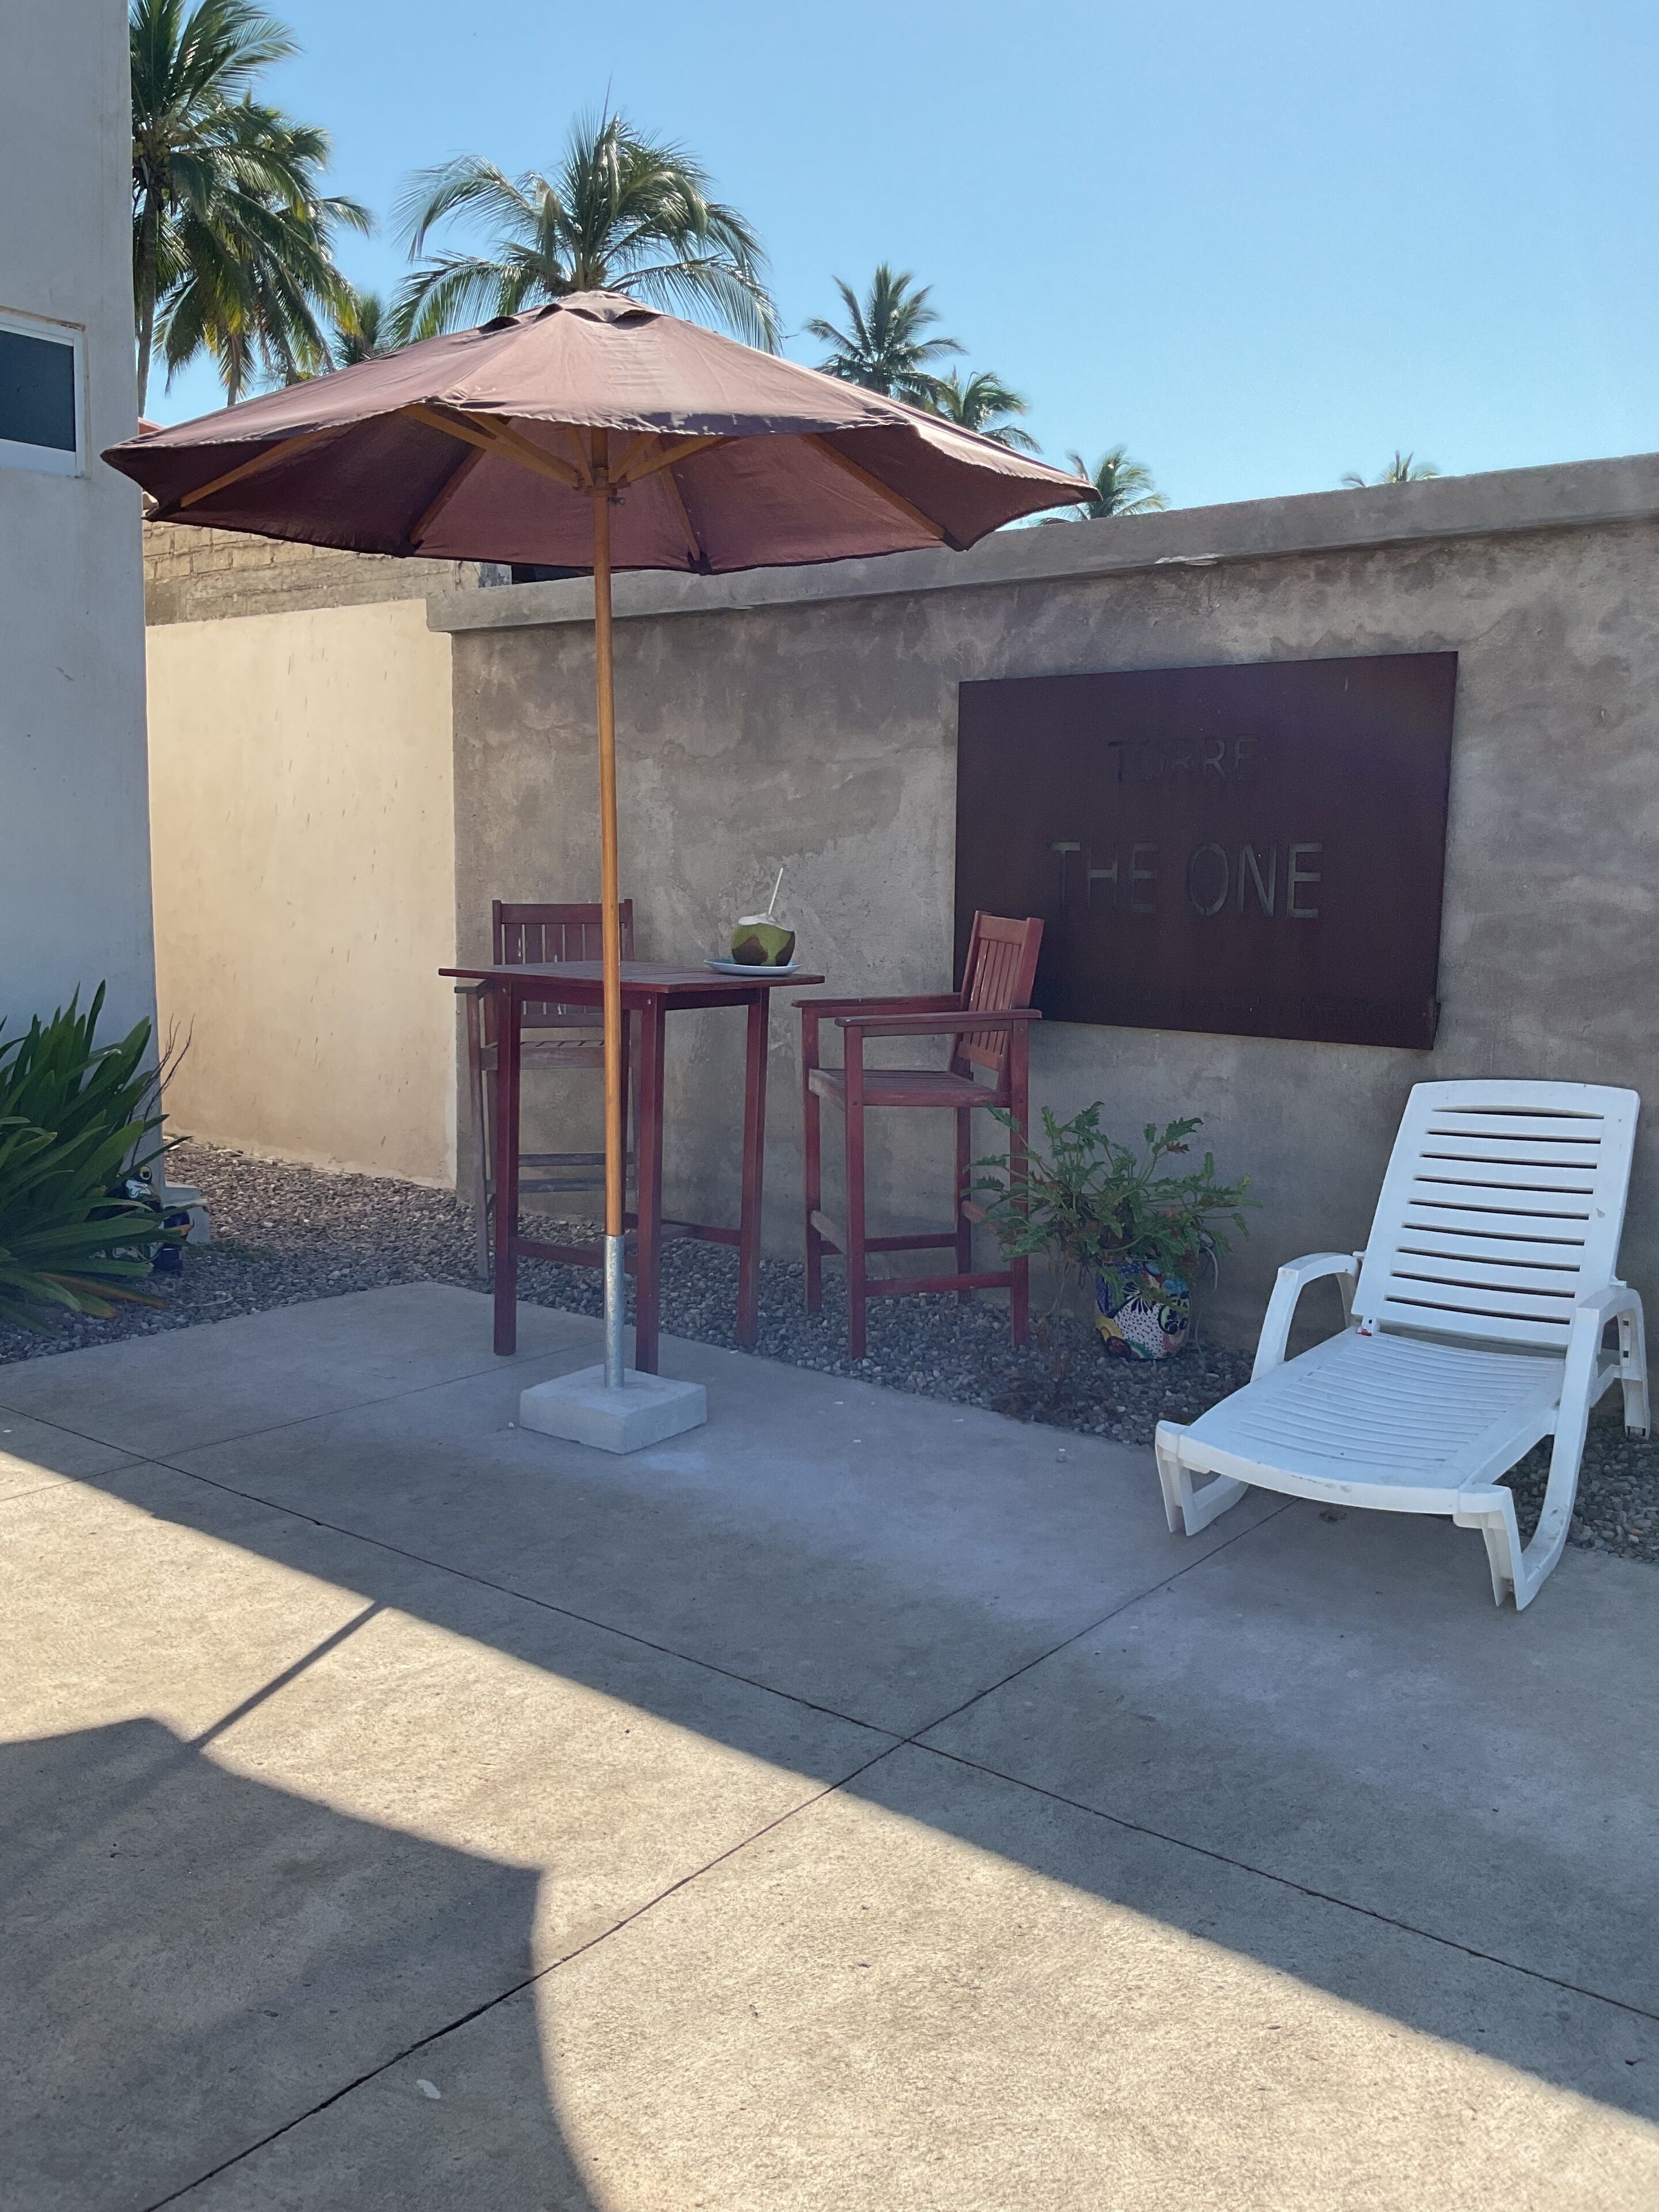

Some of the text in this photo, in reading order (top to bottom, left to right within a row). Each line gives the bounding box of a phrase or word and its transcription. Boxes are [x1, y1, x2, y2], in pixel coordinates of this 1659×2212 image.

[1107, 734, 1260, 782] TRRE
[1048, 840, 1323, 918] THE ONE
